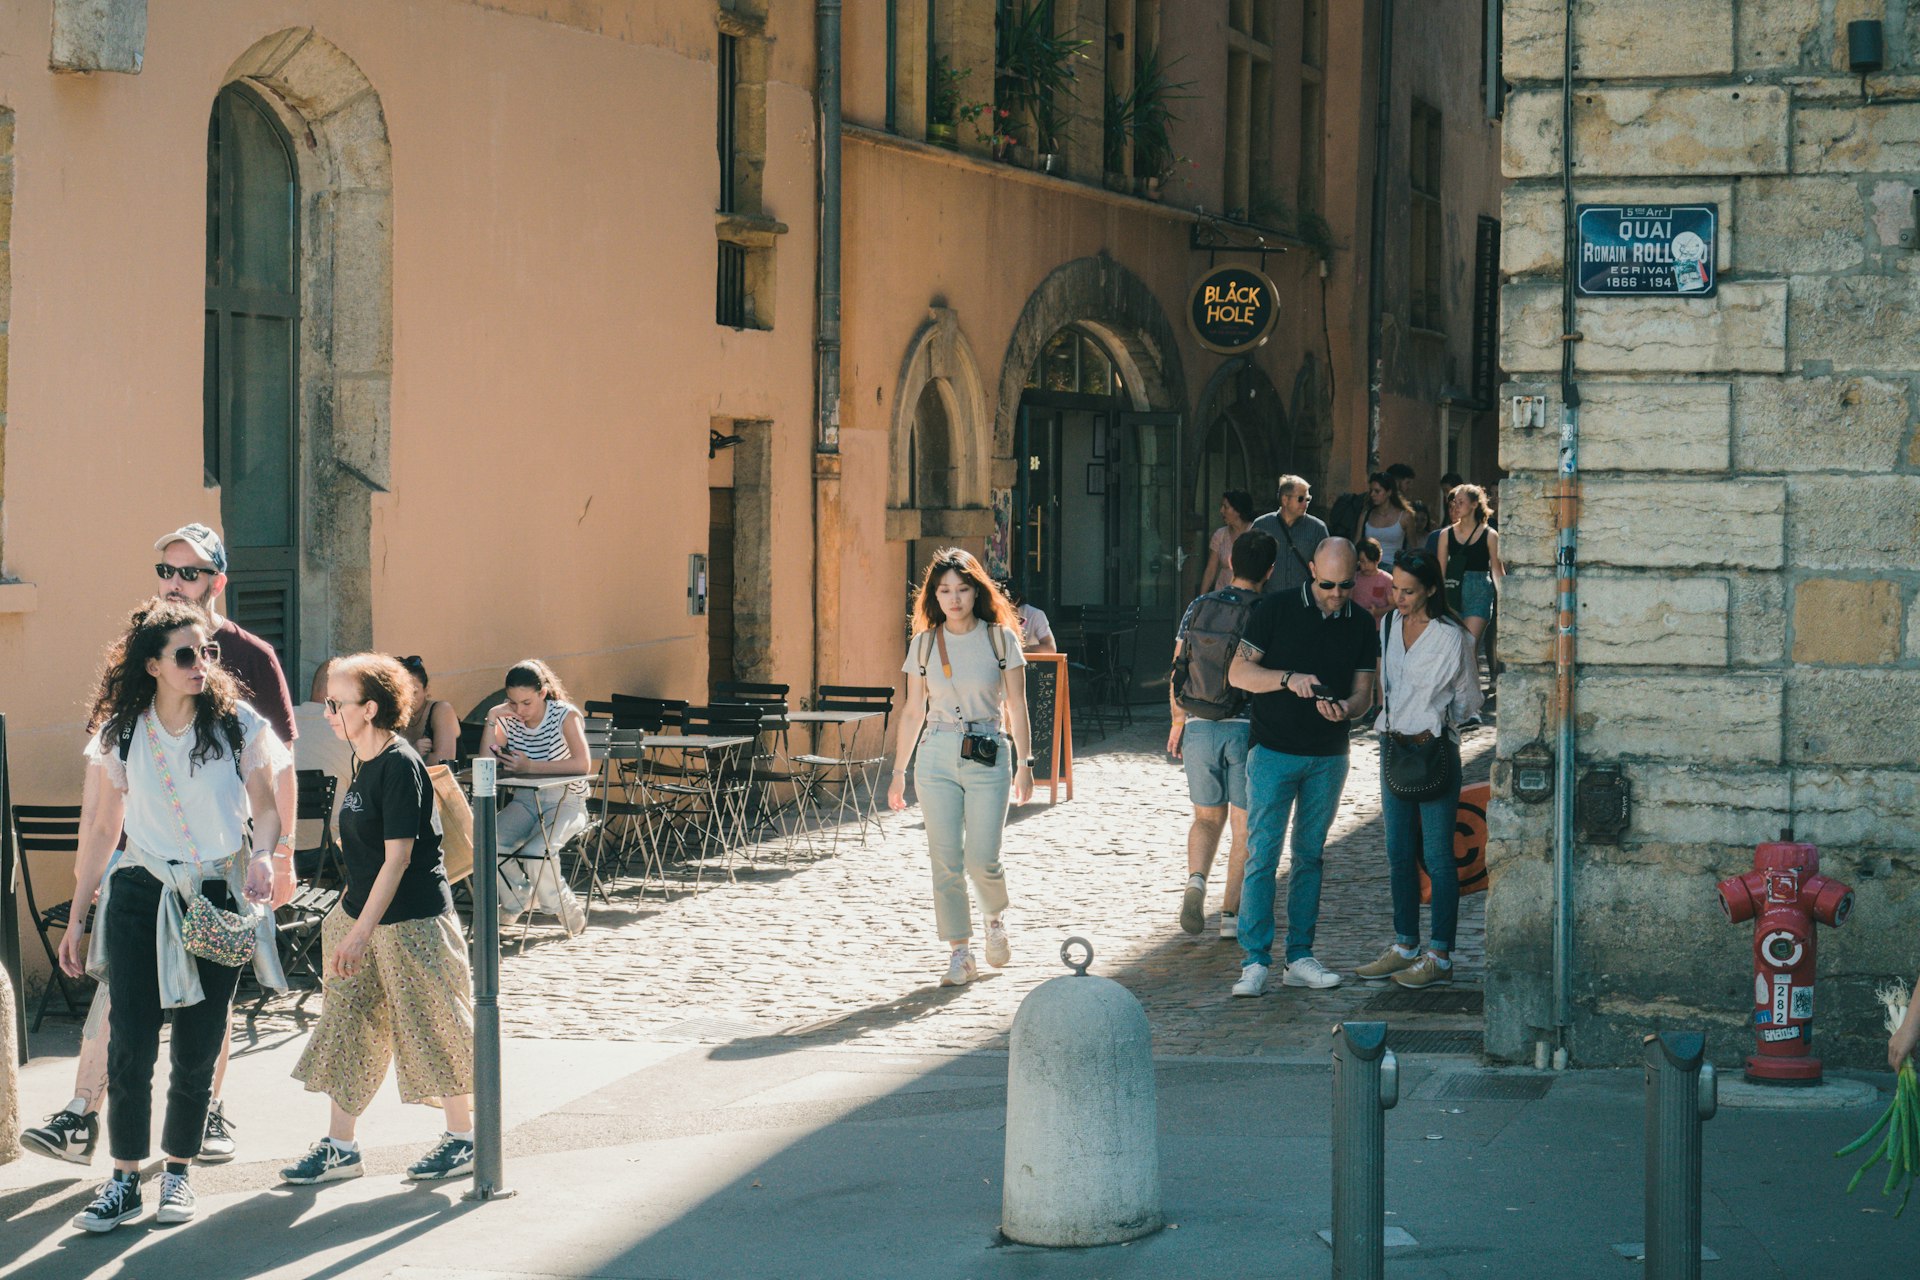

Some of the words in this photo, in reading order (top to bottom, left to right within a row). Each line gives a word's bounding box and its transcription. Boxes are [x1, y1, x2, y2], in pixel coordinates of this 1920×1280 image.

[1619, 221, 1672, 241] QUAI
[1606, 277, 1637, 288] 1866
[1206, 305, 1256, 326] HOLE
